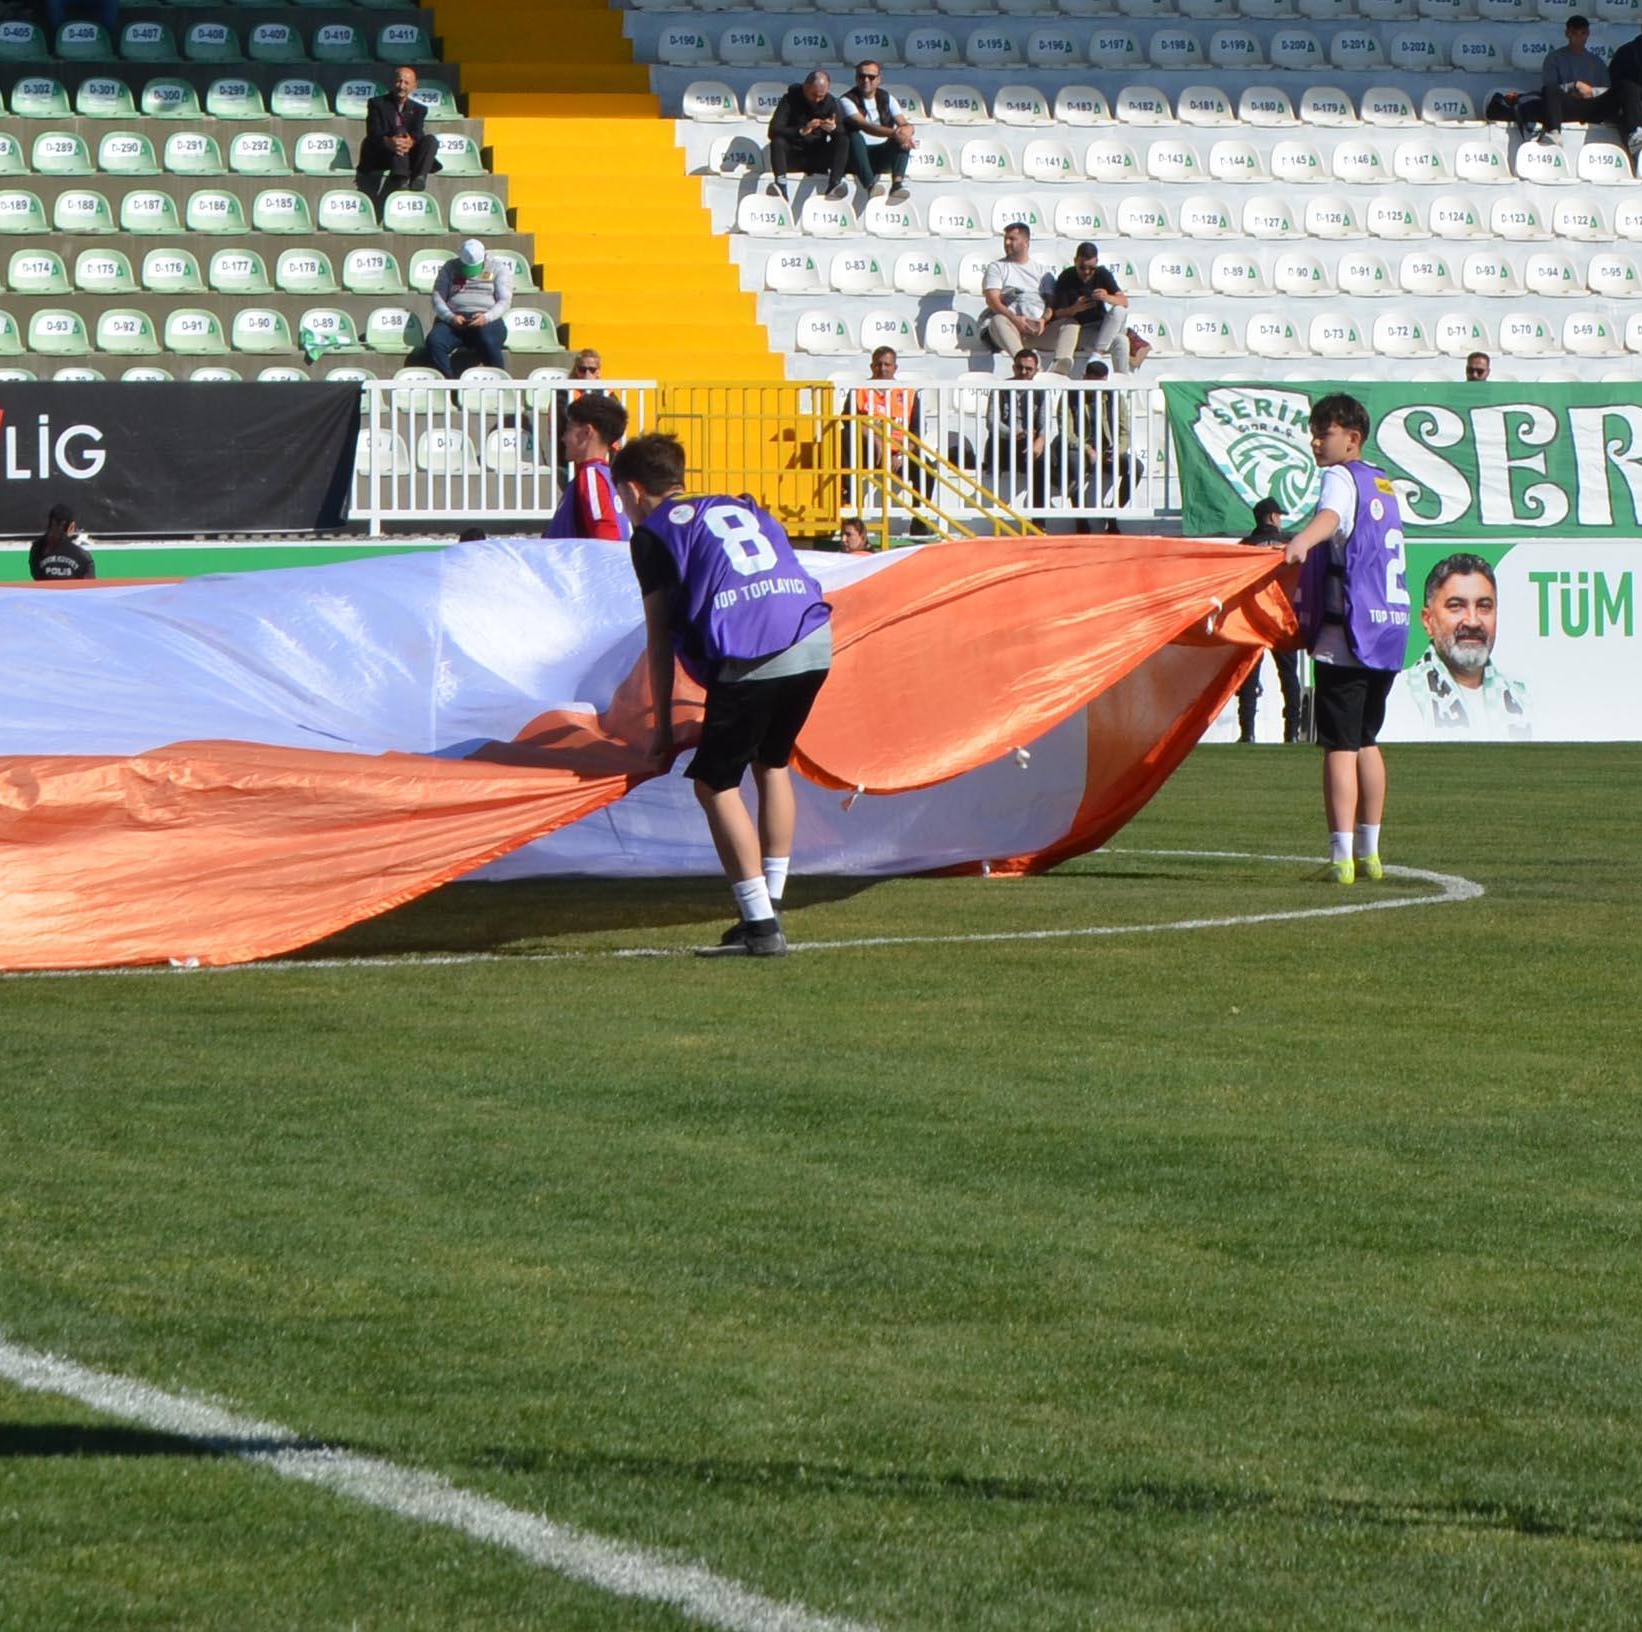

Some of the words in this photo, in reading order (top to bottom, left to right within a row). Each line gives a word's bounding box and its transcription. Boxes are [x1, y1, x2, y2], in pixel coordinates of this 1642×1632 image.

[792, 35, 819, 47] D-192
[1099, 39, 1125, 51] D-197
[1280, 40, 1307, 51] D-200
[23, 84, 53, 96] D-302
[88, 83, 116, 95] D-301
[218, 85, 246, 97] D-299
[283, 85, 312, 96] D-298
[943, 99, 971, 110] D-185
[1066, 101, 1093, 113] D-183
[1128, 101, 1155, 112] D-182
[1189, 100, 1215, 111] D-181
[1251, 101, 1277, 112] D-180
[1312, 102, 1339, 113] D-179
[1372, 104, 1400, 114] D-178
[110, 143, 138, 153] D-290
[176, 140, 202, 151] D-291
[307, 140, 334, 151] D-293
[1588, 155, 1615, 166] D-150
[133, 200, 160, 211] D-187
[198, 200, 225, 212] D-186
[264, 198, 293, 209] D-185
[330, 200, 358, 211] D-184
[396, 201, 424, 212] D-183
[461, 201, 489, 212] D-182
[1377, 210, 1404, 222] D-125
[1500, 213, 1527, 224] D-123
[154, 263, 182, 273] D-176
[221, 261, 249, 272] D-177
[288, 262, 317, 273] D-178
[356, 257, 384, 269] D-179
[780, 257, 802, 268] D-82
[844, 260, 867, 271] D-83
[908, 263, 930, 273] D-84
[1222, 266, 1245, 277] D-89
[1412, 264, 1434, 275] D-92
[1475, 265, 1497, 277] D-93
[46, 320, 69, 332] D-93
[181, 320, 203, 331] D-91
[248, 317, 271, 329] D-90
[312, 318, 335, 329] D-89
[381, 316, 403, 327] D-88
[513, 316, 536, 328] D-86
[874, 321, 897, 332] D-80
[113, 322, 135, 333] D-92
[810, 322, 832, 334] D-81
[1195, 322, 1218, 333] D-75
[1259, 325, 1281, 336] D-74
[1387, 326, 1409, 337] D-72
[1510, 324, 1532, 336] D-70
[1572, 325, 1594, 336] D-69
[703, 504, 778, 576] 8
[1528, 570, 1634, 638] TÜM
[1369, 609, 1388, 624] TOP
